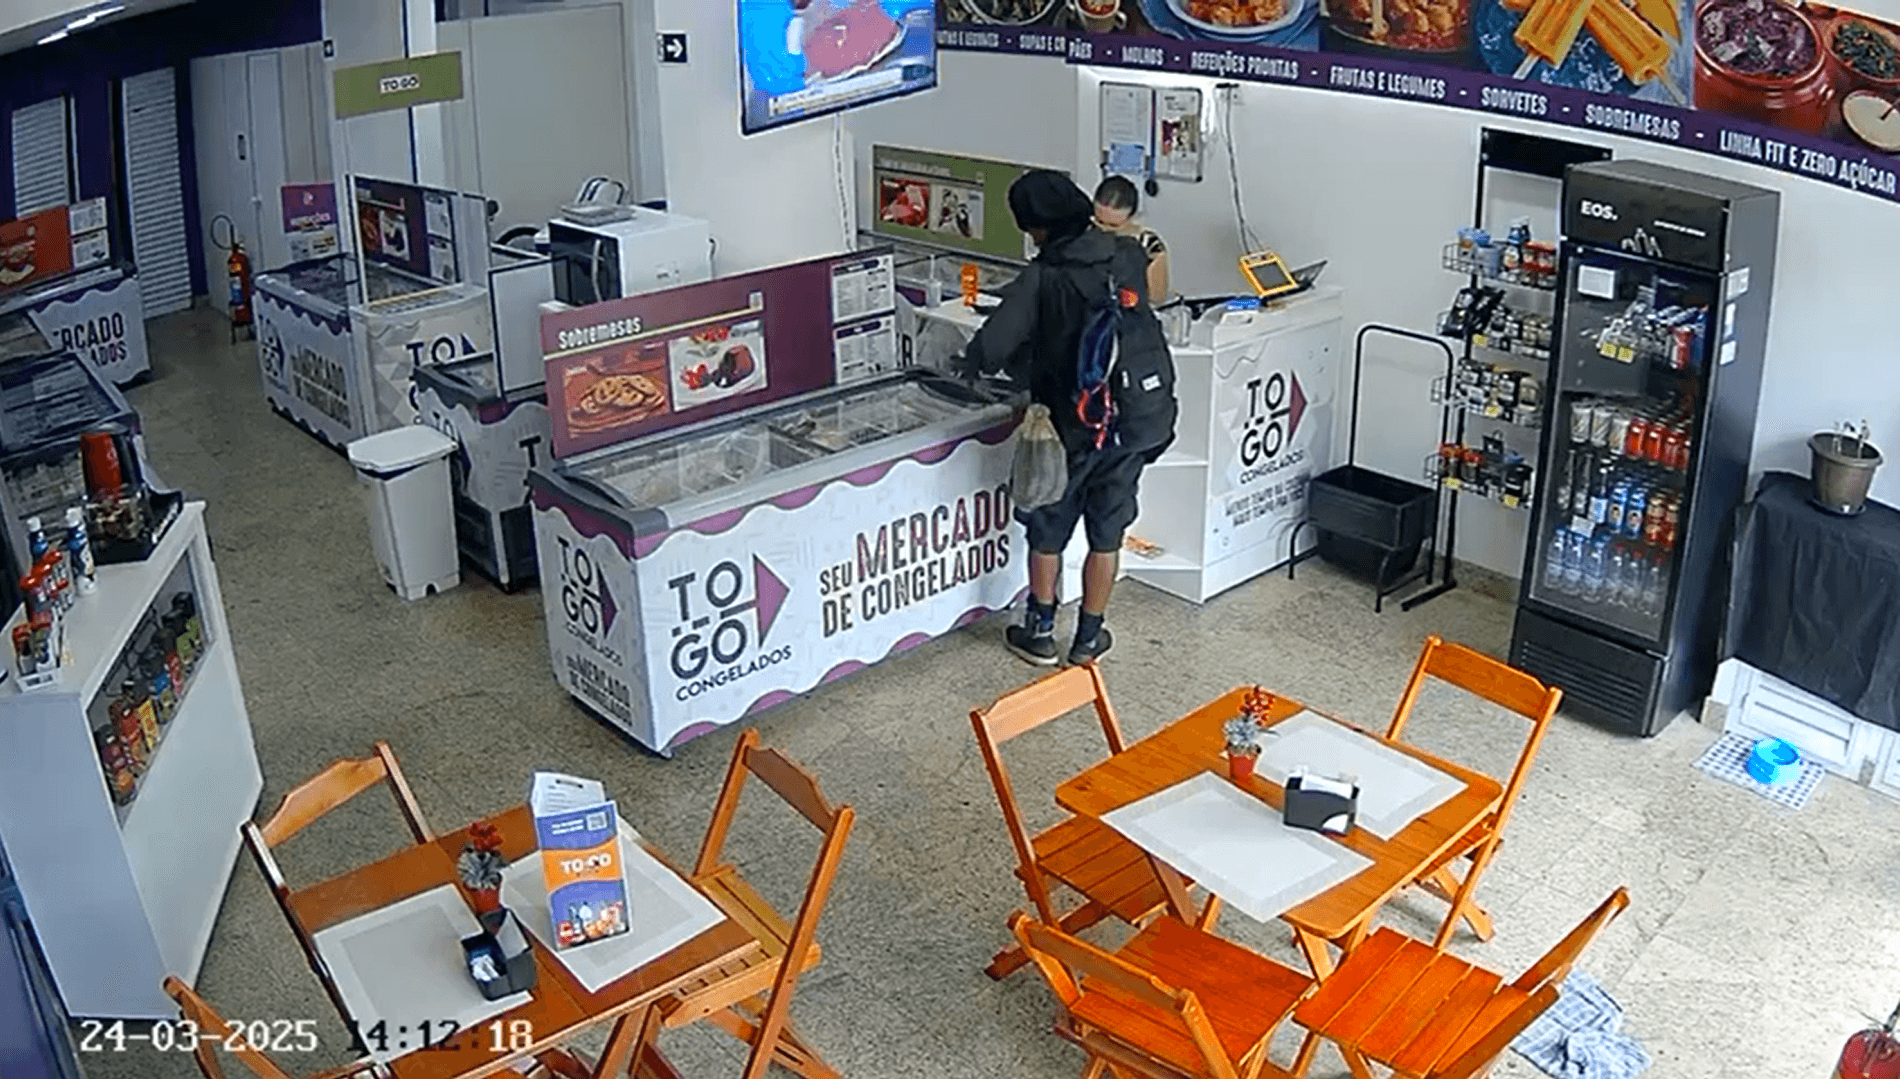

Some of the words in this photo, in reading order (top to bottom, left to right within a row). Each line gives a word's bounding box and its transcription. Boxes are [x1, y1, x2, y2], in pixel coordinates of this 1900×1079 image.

[1069, 37, 1093, 59] PÃES
[1122, 45, 1164, 65] MOLHOS
[1191, 51, 1245, 76] REFEIÇÕES
[1248, 56, 1299, 80] PRONTAS
[1330, 65, 1375, 90] FRUTAS
[1378, 71, 1385, 90] E
[1388, 73, 1446, 99] LEGUMES
[1481, 86, 1548, 115] SORVETES
[1585, 103, 1681, 140] SOBREMESAS
[1719, 129, 1763, 159] LINHA
[1765, 140, 1788, 164] FIT
[1789, 146, 1799, 168] E
[1801, 149, 1837, 178] ZERO
[1838, 157, 1897, 195] AÇÚCAR
[1247, 372, 1285, 417] TO
[1240, 421, 1282, 467] GO
[1240, 450, 1304, 485] CONGELADOS
[557, 535, 592, 586] TO
[820, 561, 853, 596] SEU
[856, 483, 1011, 583] MERCADO
[562, 584, 598, 635] GO
[668, 560, 743, 622] TO
[822, 593, 854, 638] DE
[861, 533, 1010, 621] CONGELADOS
[670, 618, 747, 680] GO
[675, 645, 792, 702] CONGELADOS
